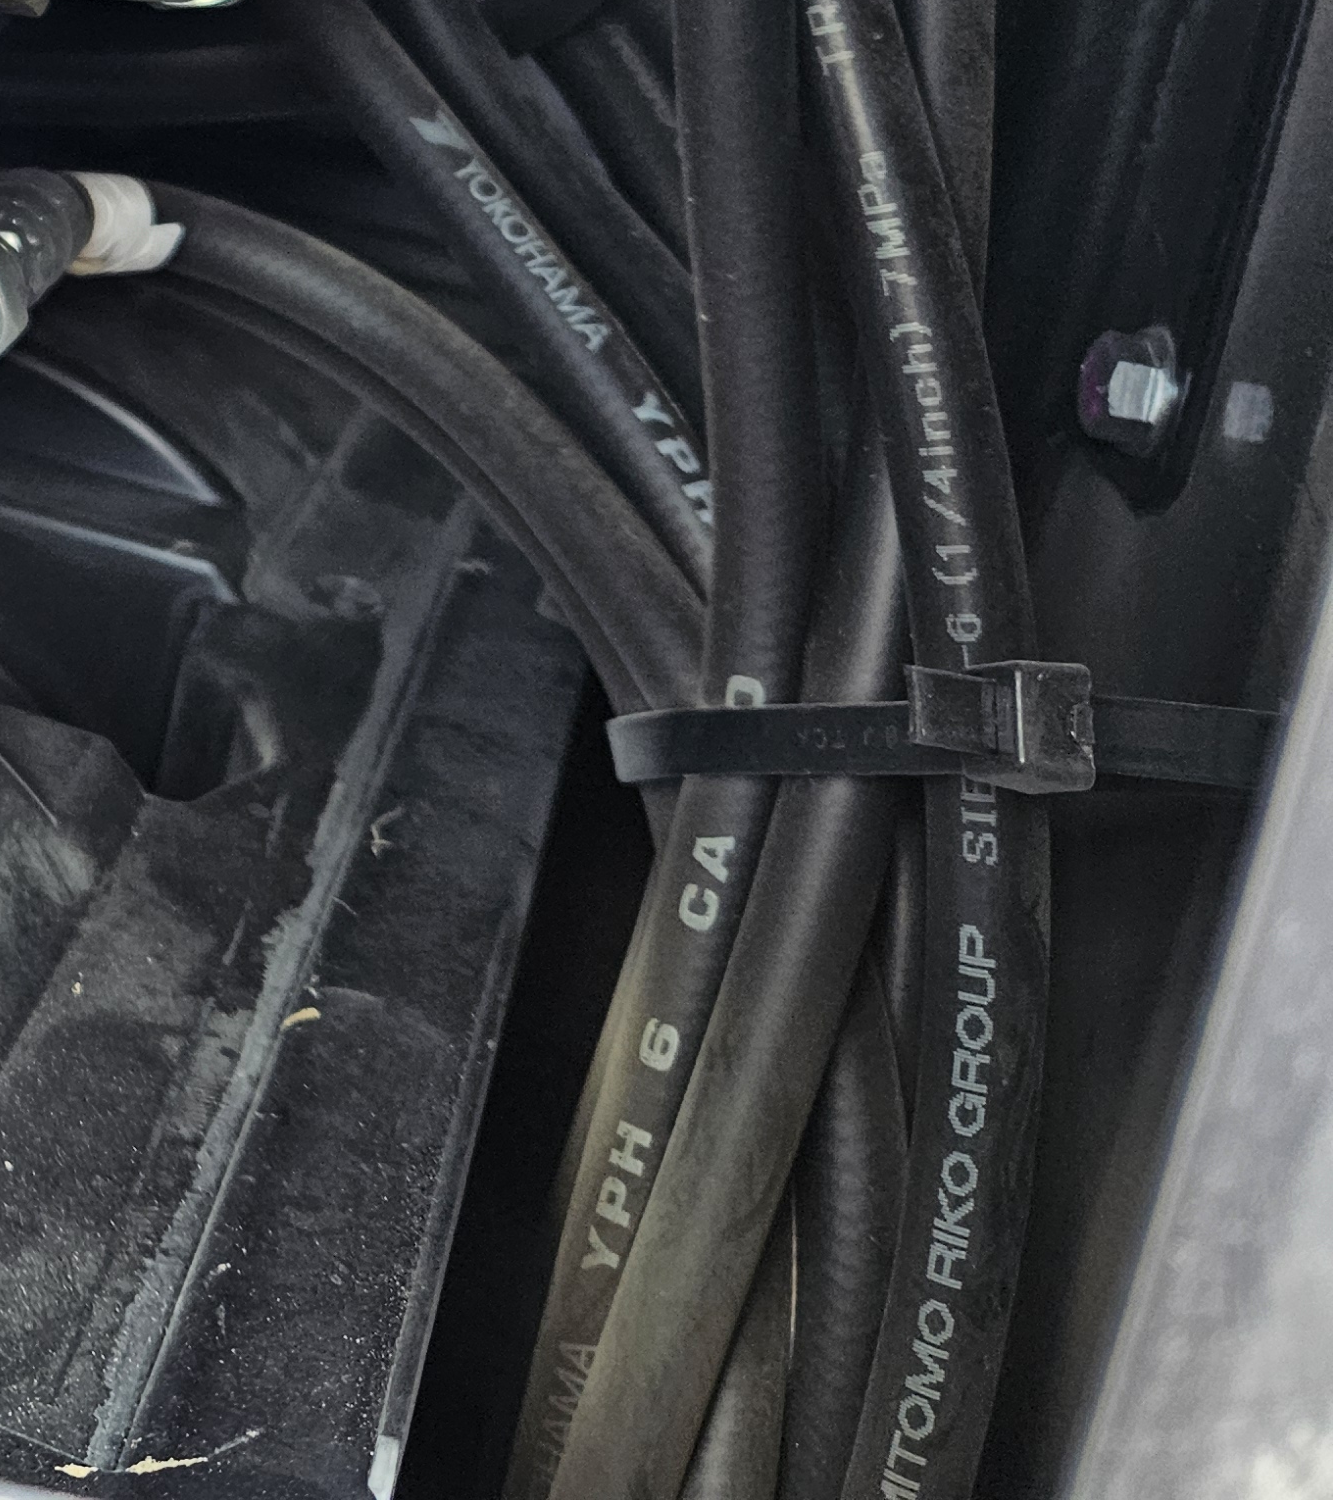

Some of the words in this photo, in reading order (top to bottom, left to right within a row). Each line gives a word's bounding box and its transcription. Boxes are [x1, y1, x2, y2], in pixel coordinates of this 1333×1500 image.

[452, 157, 608, 352] YOKOHAMA
[946, 924, 997, 1139] GROUP
[581, 1120, 654, 1273] YPH
[638, 1017, 681, 1073] 6
[926, 1150, 979, 1291] RIKO
